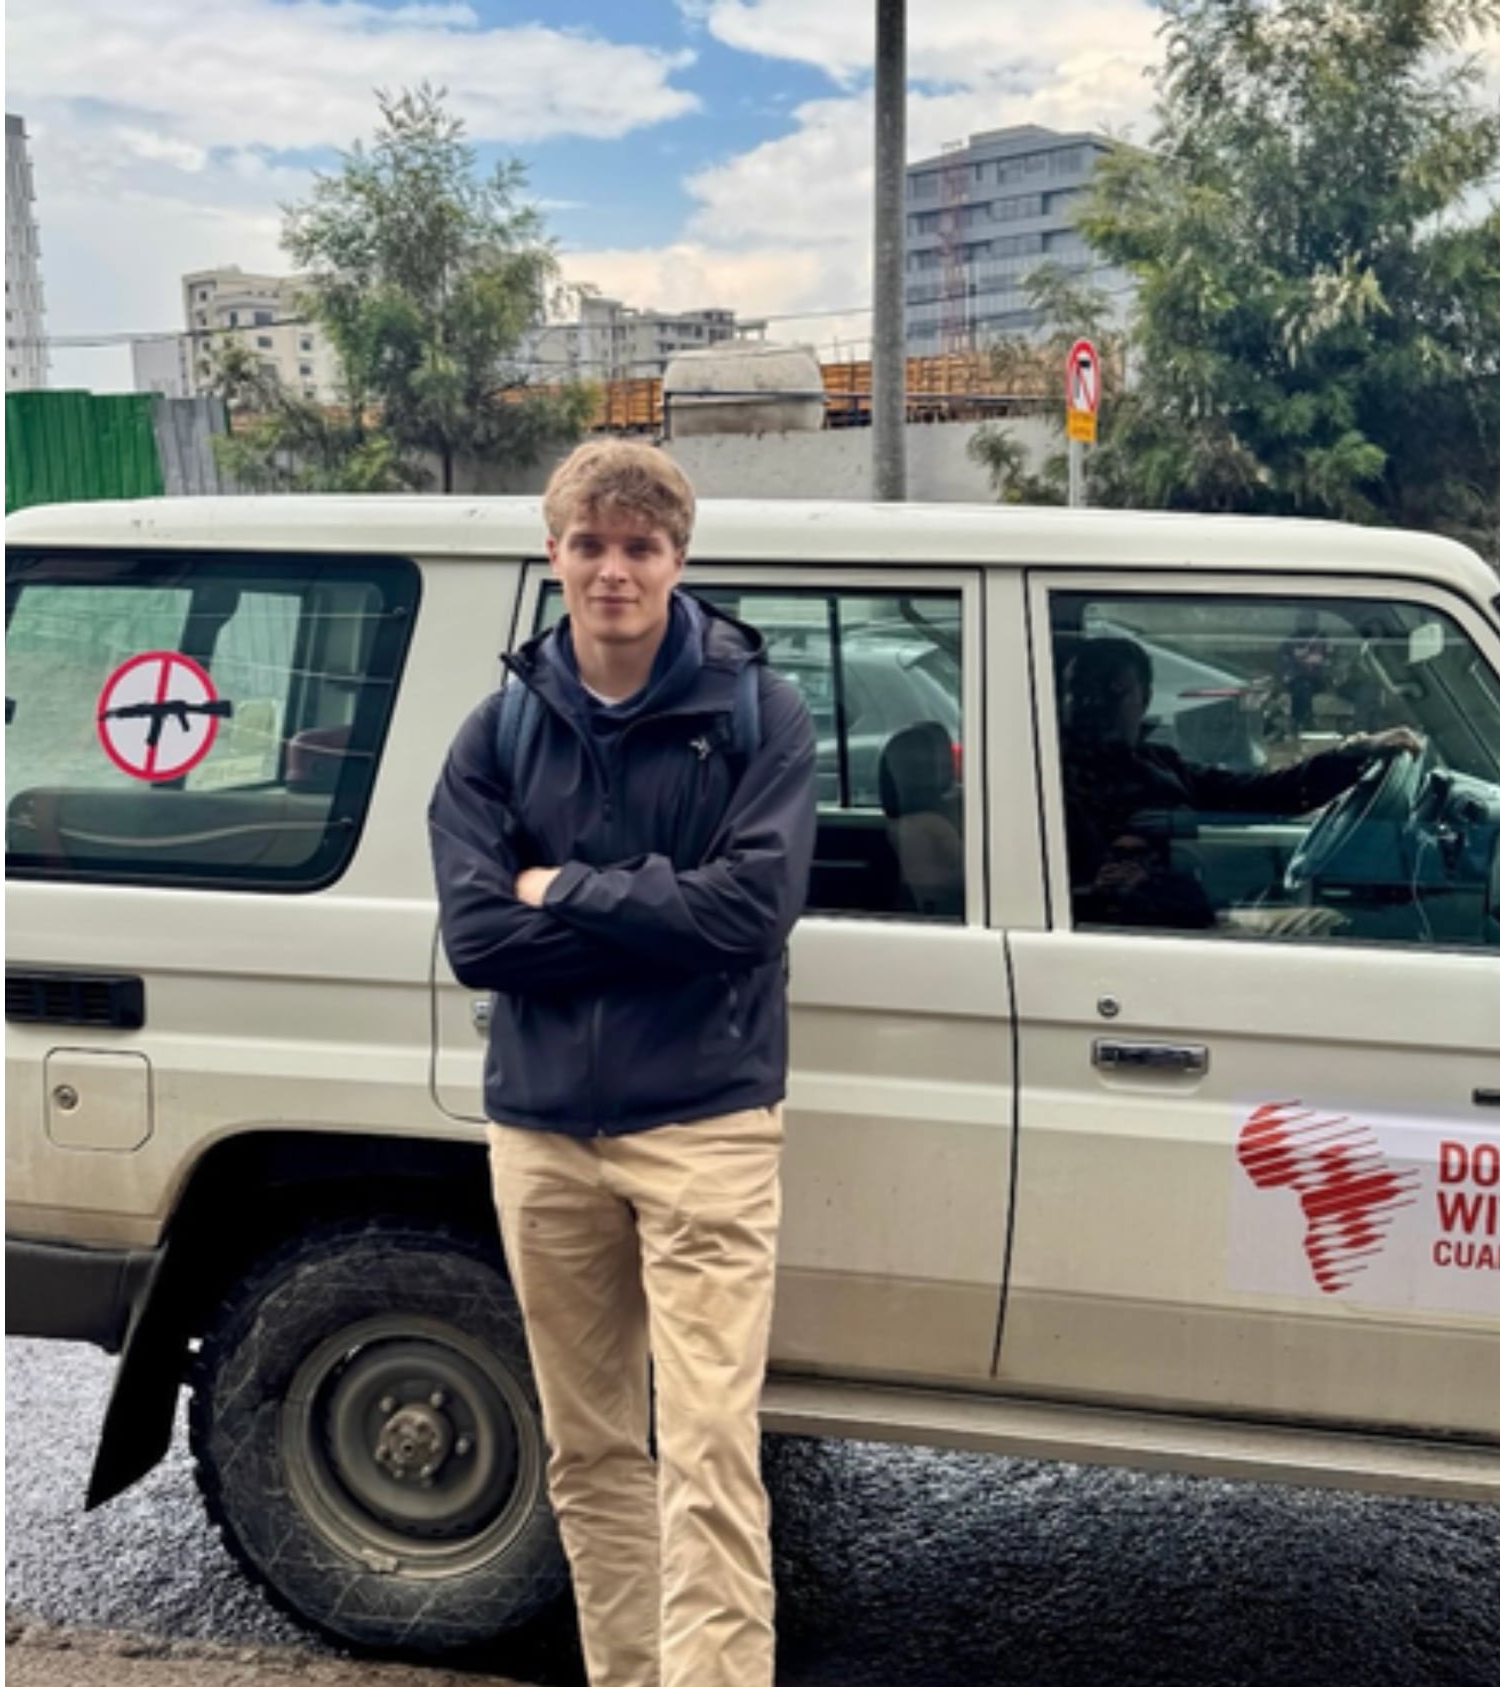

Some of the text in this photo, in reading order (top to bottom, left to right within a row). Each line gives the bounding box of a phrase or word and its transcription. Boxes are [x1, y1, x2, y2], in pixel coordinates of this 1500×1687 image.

[1440, 1141, 1500, 1186] DO
[1437, 1190, 1497, 1235] WI
[1433, 1241, 1500, 1269] CUA
